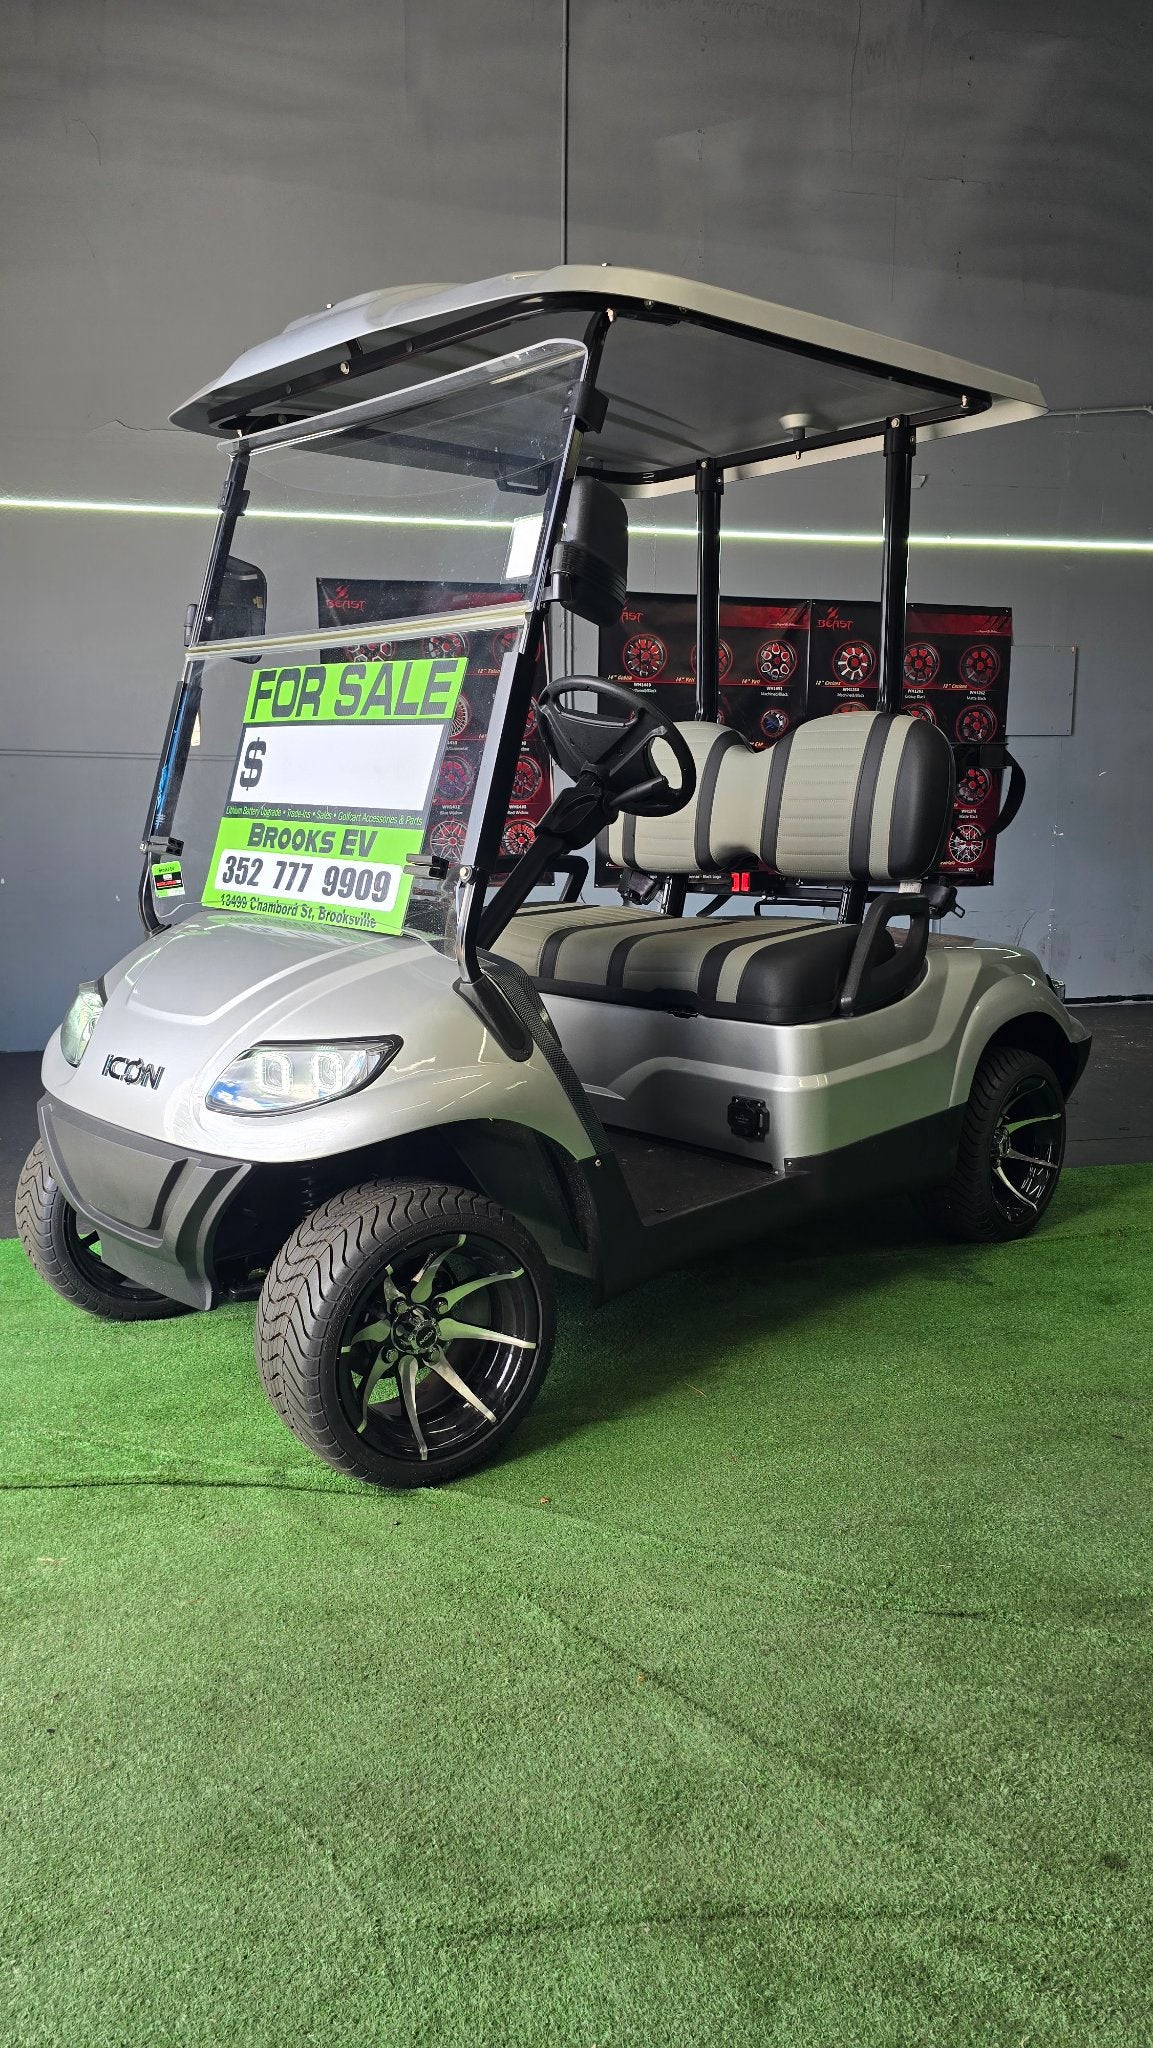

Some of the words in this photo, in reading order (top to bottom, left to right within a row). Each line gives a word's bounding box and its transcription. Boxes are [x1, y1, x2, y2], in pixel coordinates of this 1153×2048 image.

[325, 599, 366, 612] BEAST
[816, 619, 853, 630] BEAST
[250, 665, 326, 719] FOR
[334, 660, 458, 717] SALE
[240, 737, 267, 791] $
[226, 806, 242, 814] Lithium
[243, 806, 260, 817] Battery
[261, 807, 281, 818] Upgrade
[316, 811, 333, 819] Sales
[362, 813, 398, 824] Accessories
[399, 815, 404, 824] &
[405, 815, 423, 825] Parts
[247, 822, 336, 854] BROOKS
[340, 828, 378, 858] EV
[222, 855, 264, 887] 352
[273, 860, 313, 892] 777
[322, 865, 392, 903] 9909
[220, 894, 247, 908] 13499
[250, 896, 298, 916] Chambord
[300, 903, 315, 921] St,
[318, 906, 377, 928] Brooksville
[101, 1054, 166, 1090] ICON
[419, 1330, 435, 1345] ICON
